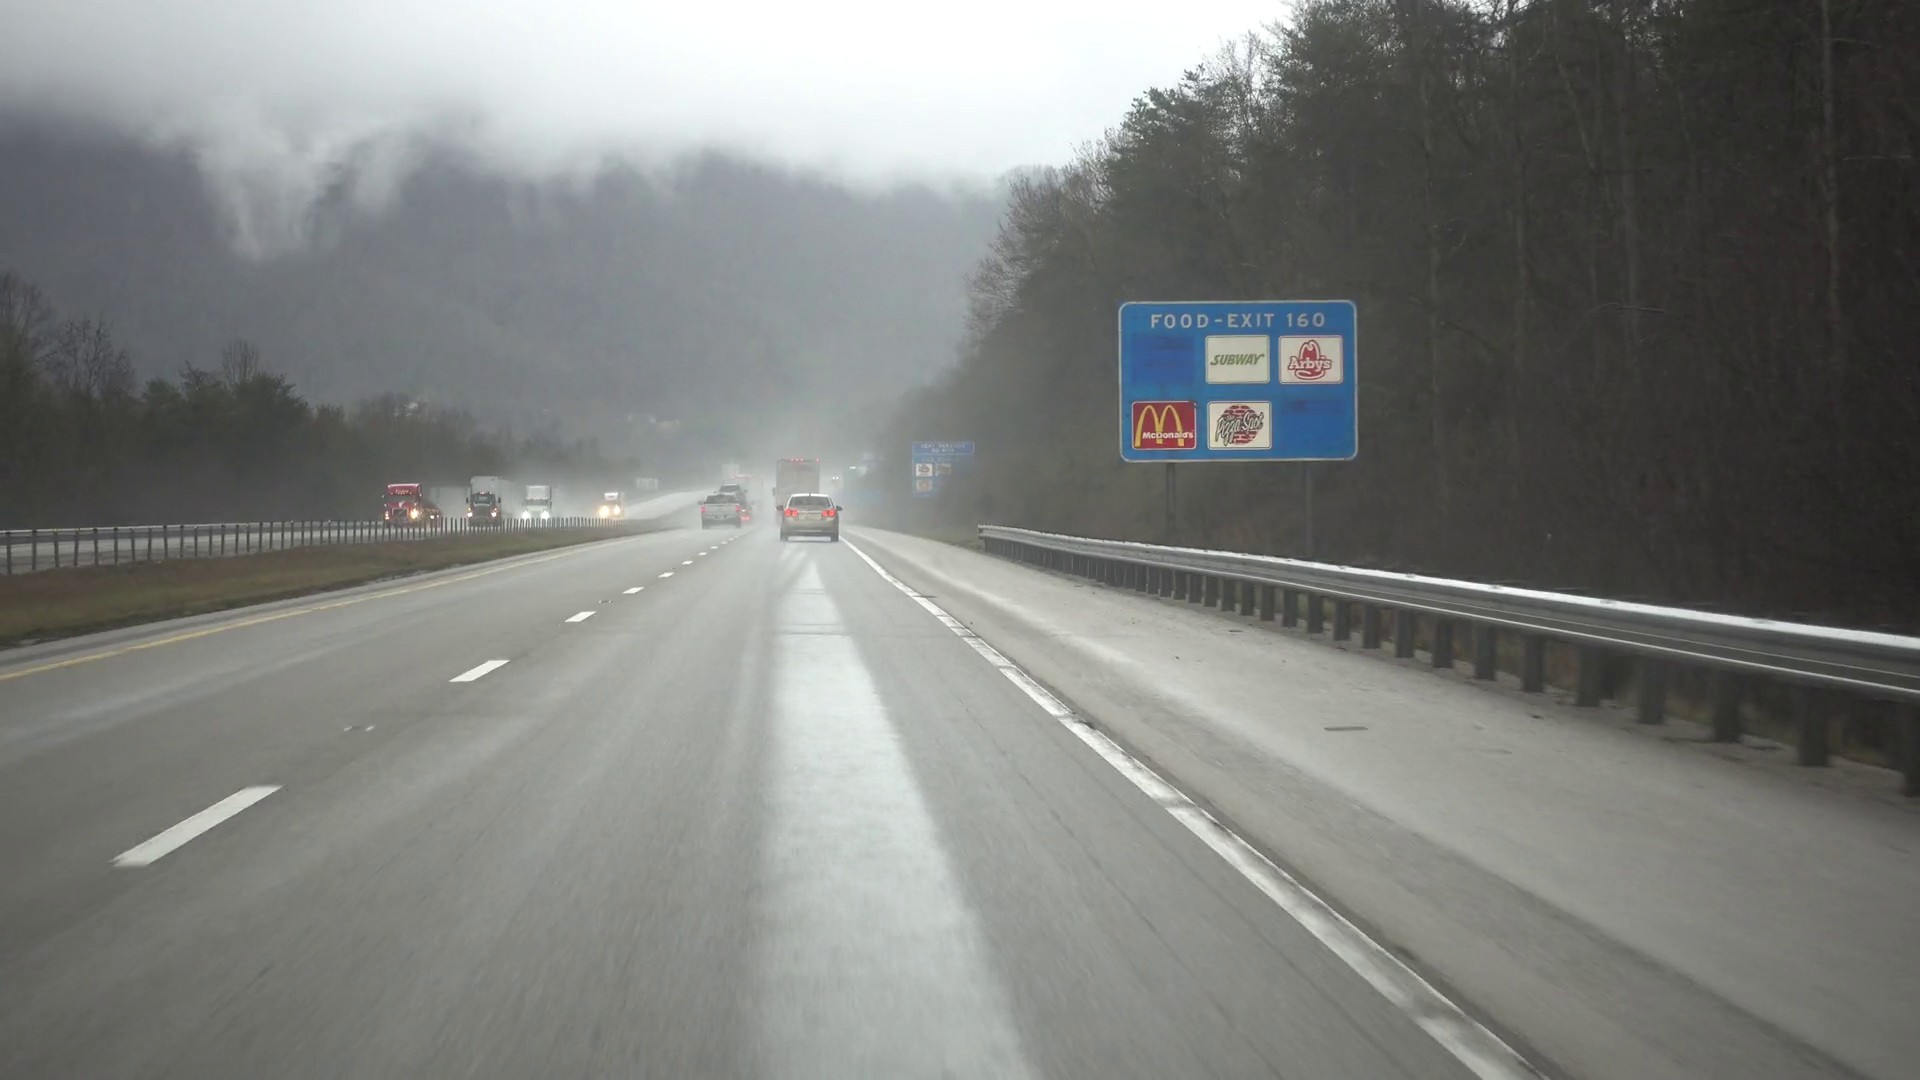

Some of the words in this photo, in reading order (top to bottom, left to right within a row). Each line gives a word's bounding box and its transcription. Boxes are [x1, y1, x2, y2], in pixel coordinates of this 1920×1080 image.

[1287, 312, 1326, 328] 160
[1210, 353, 1264, 366] SUBWAY
[1288, 355, 1333, 371] Arby's
[1142, 431, 1194, 440] McDonald's
